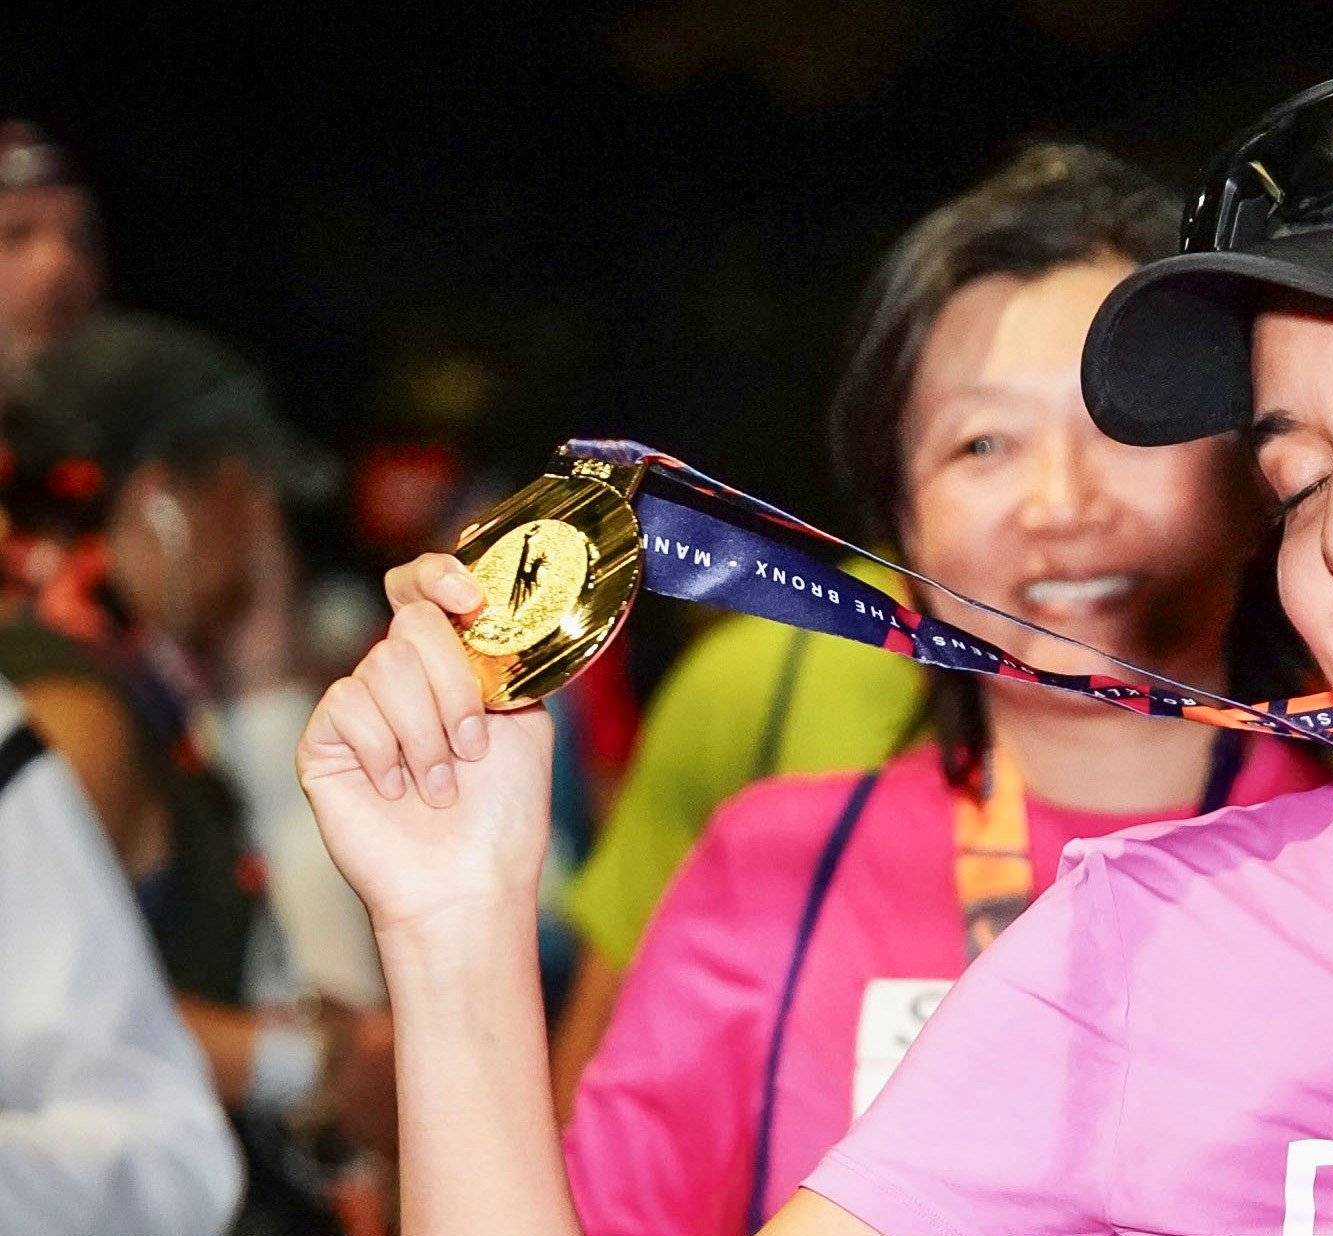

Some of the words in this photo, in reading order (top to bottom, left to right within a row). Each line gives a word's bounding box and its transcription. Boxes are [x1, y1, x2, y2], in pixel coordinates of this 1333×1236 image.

[755, 560, 840, 604] BRONX
[855, 599, 901, 628] THE
[932, 635, 1035, 675] QUEENS
